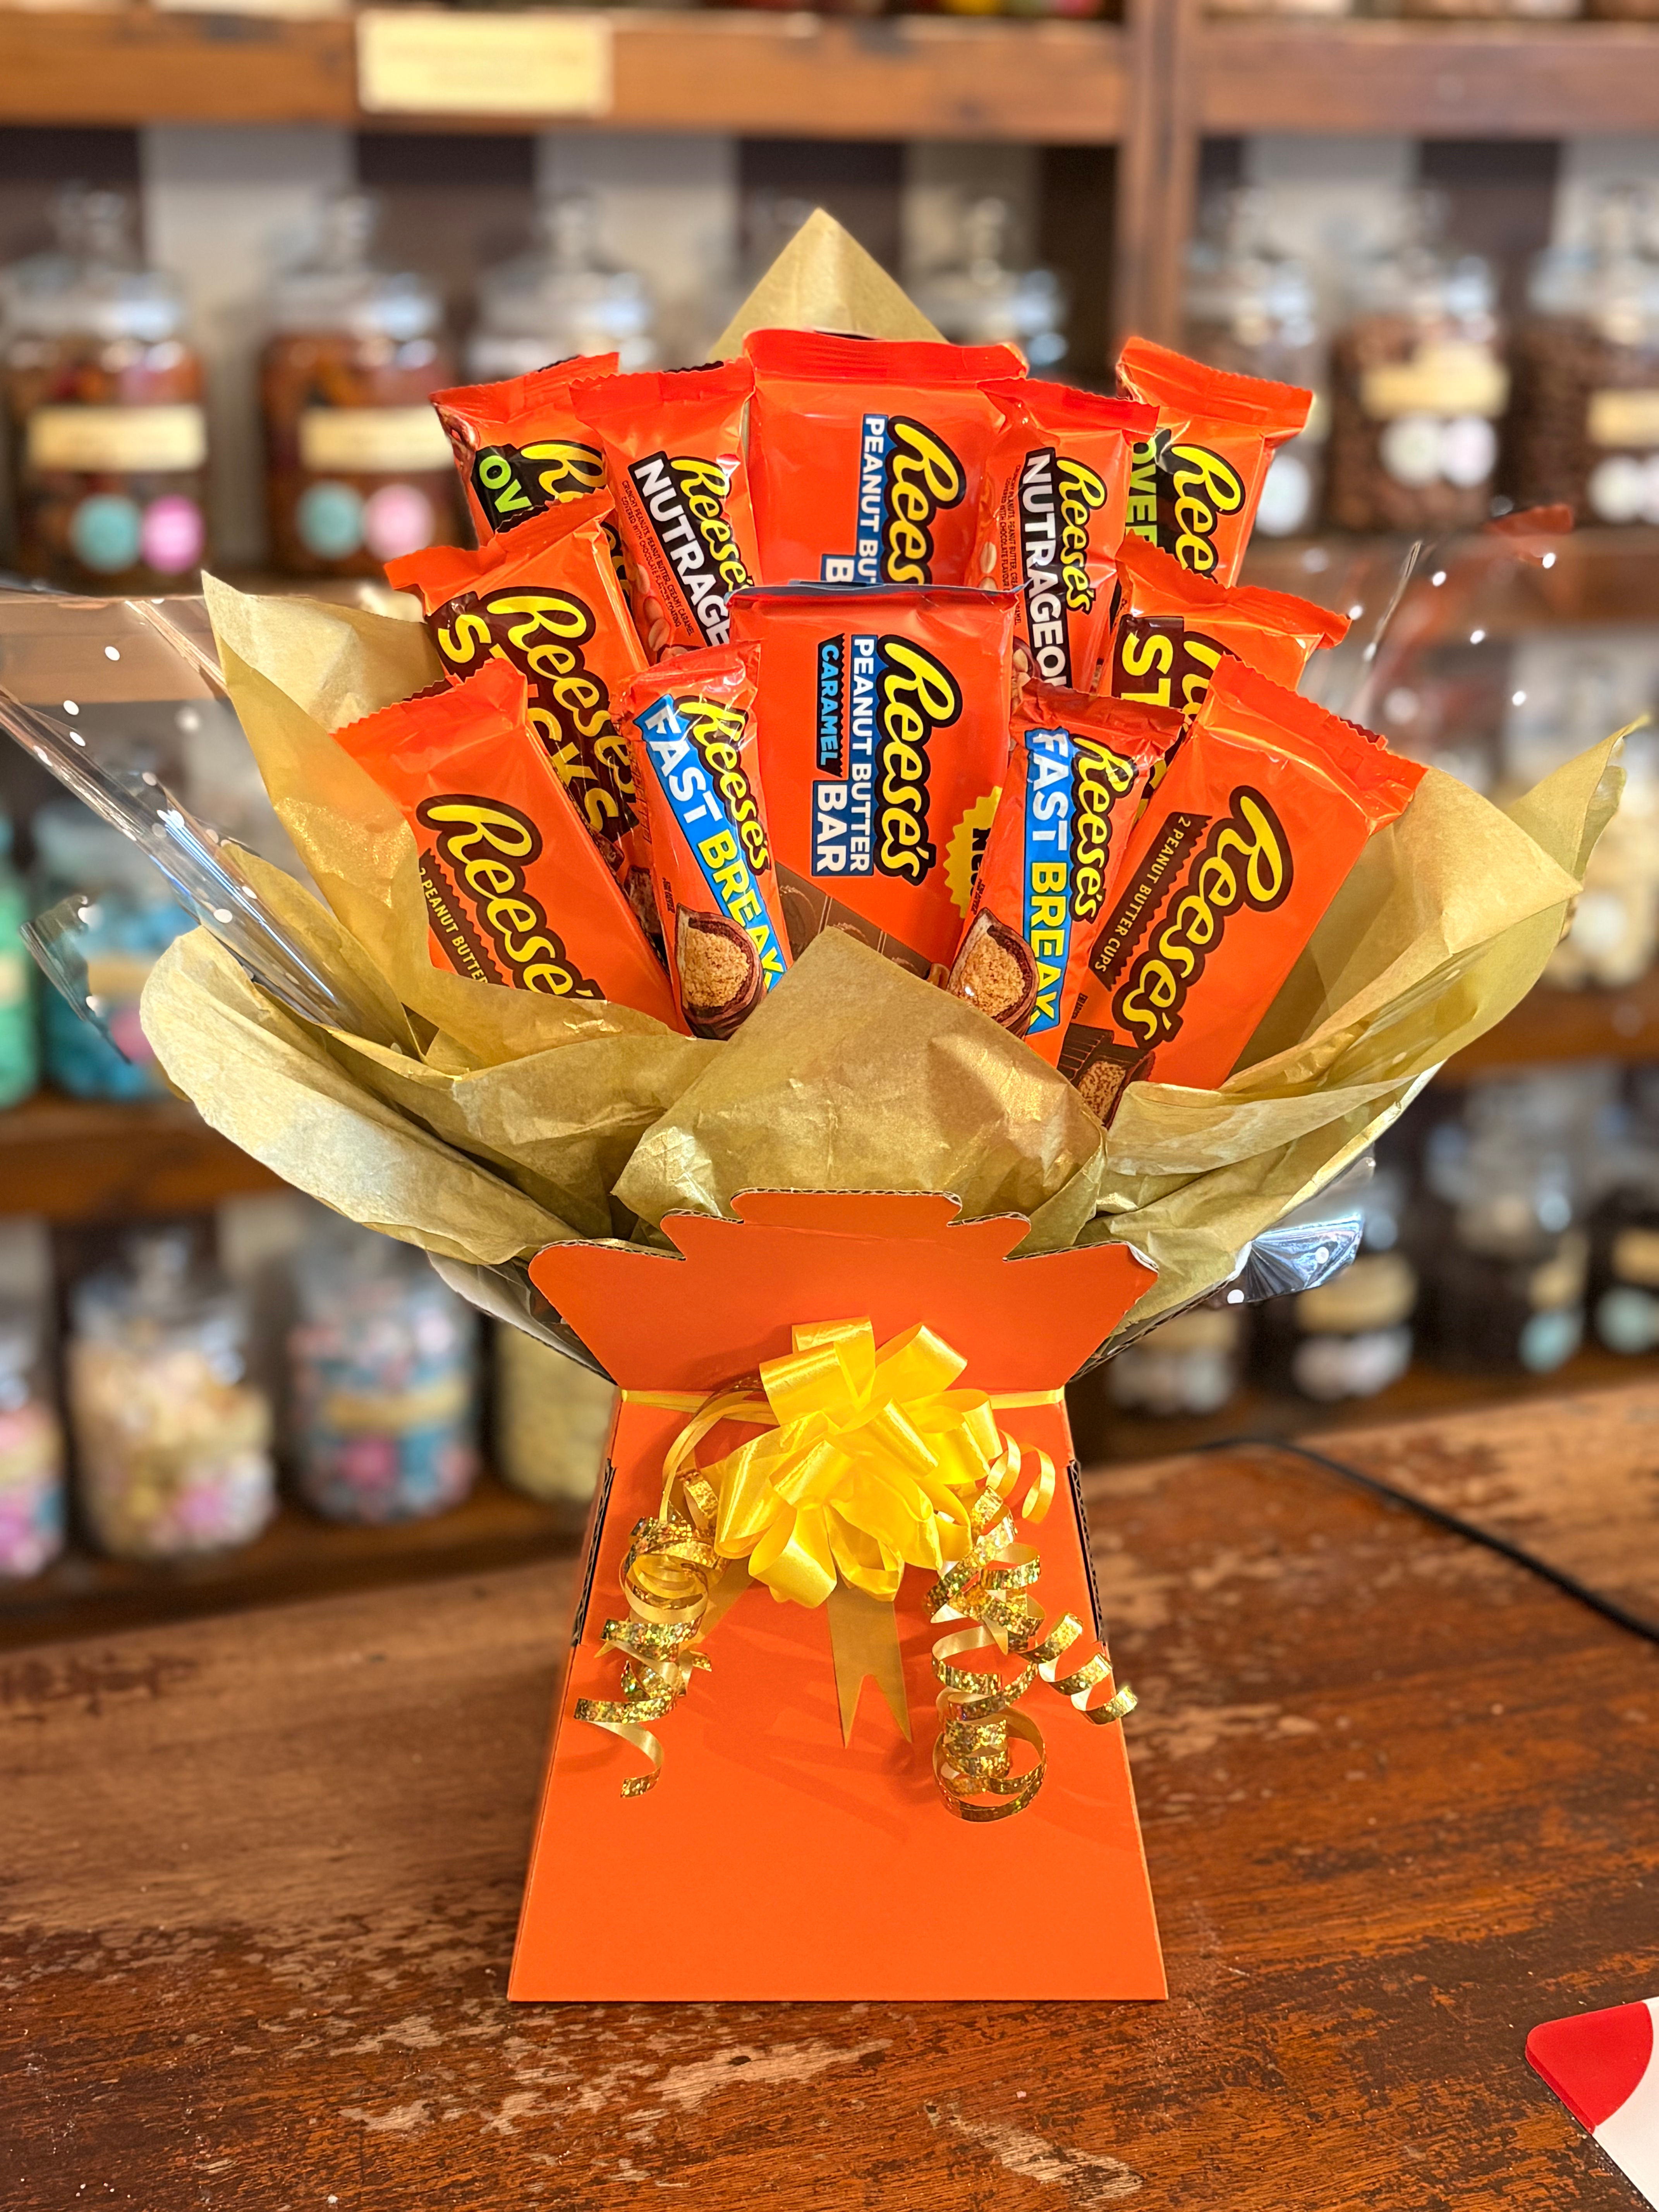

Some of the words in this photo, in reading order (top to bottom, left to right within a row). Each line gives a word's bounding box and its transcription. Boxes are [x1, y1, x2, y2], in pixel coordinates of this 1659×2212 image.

[860, 418, 885, 532] PEANUT
[639, 540, 659, 575] CHOCOLATE
[647, 536, 661, 560] PEANUT
[667, 584, 683, 608] CREAMY
[678, 608, 694, 636] CARAMEL
[858, 539, 878, 584] BU
[1056, 459, 1105, 611] Reese's
[819, 644, 840, 766] CARAMEL
[852, 639, 875, 756] PEANUT
[645, 705, 723, 824] FAST
[679, 702, 769, 869] Reese's
[881, 642, 955, 878] Reese's
[1032, 733, 1069, 851] FAST
[816, 785, 848, 872] BAR
[850, 768, 872, 871] BUTTER
[1073, 737, 1133, 918] Reese's
[1147, 828, 1184, 884] PEANUT
[1178, 816, 1191, 828] 2
[421, 879, 459, 933] PEANUT
[1094, 938, 1121, 972] CUPS
[1114, 883, 1152, 936] BUTTER
[1123, 796, 1283, 1041] Reese's
